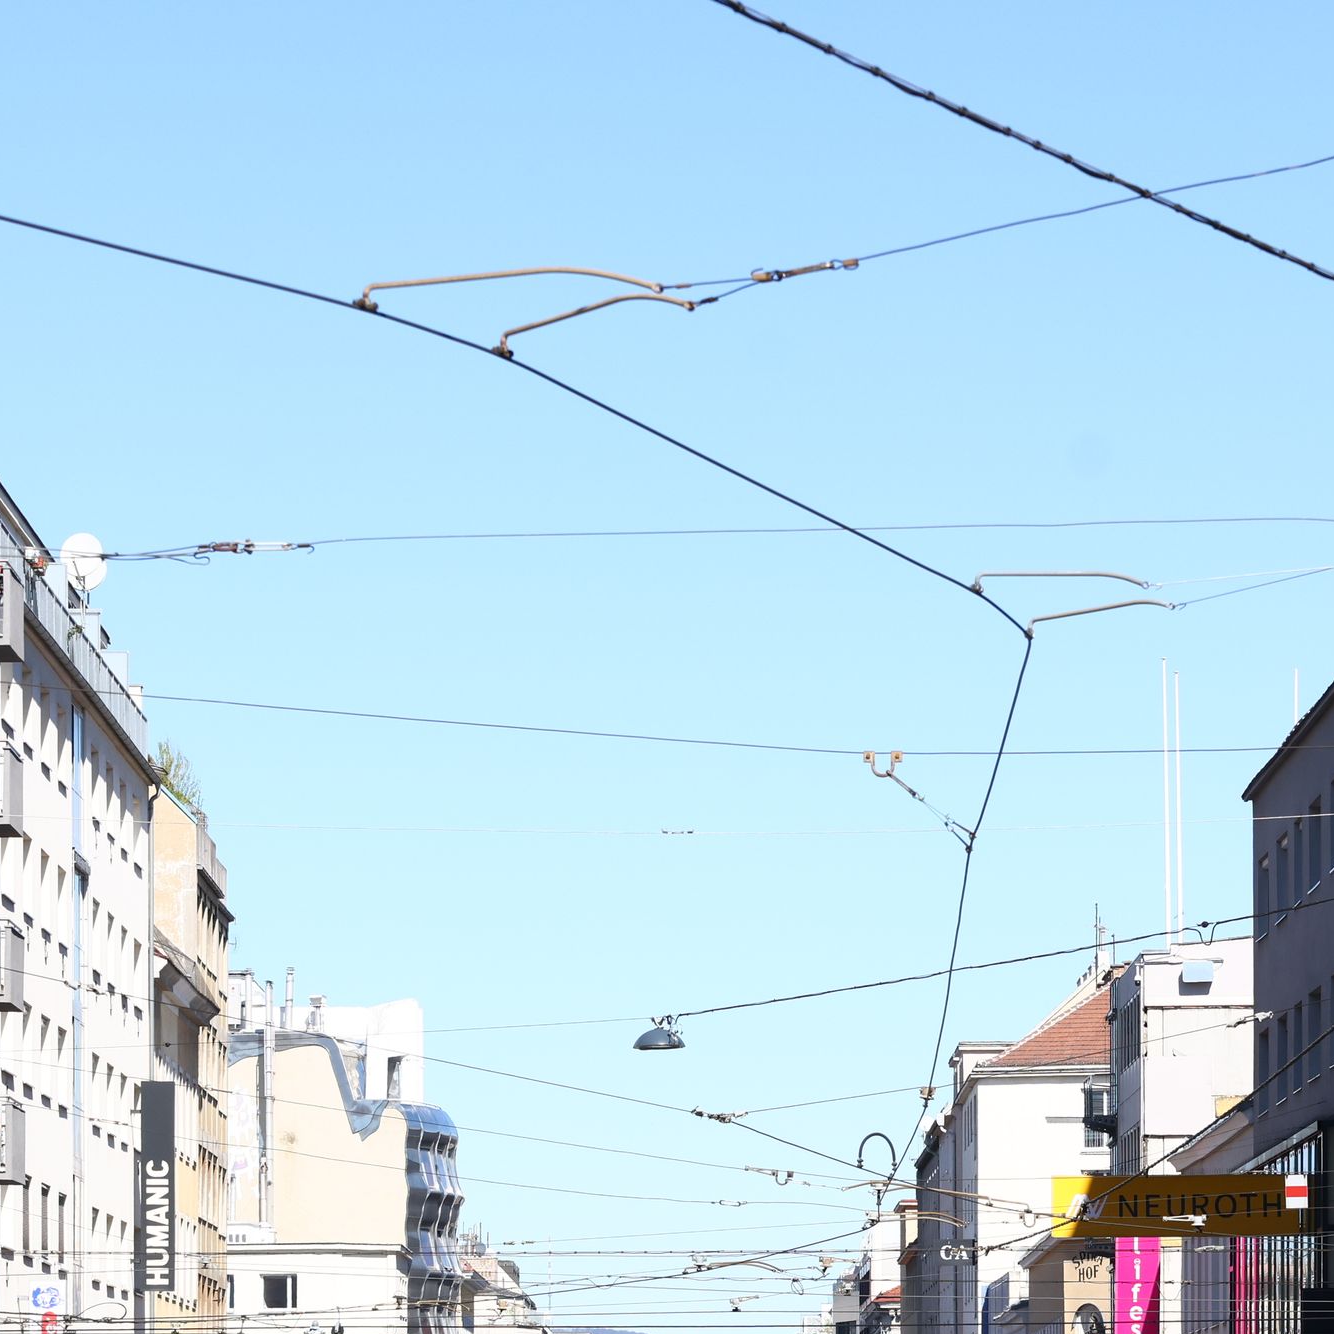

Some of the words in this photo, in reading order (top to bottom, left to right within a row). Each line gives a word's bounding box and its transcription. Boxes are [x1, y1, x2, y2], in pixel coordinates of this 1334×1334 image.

[1118, 1193, 1282, 1218] NEUROTH
[146, 1159, 169, 1286] HUMANIC
[1078, 1264, 1100, 1282] HOF
